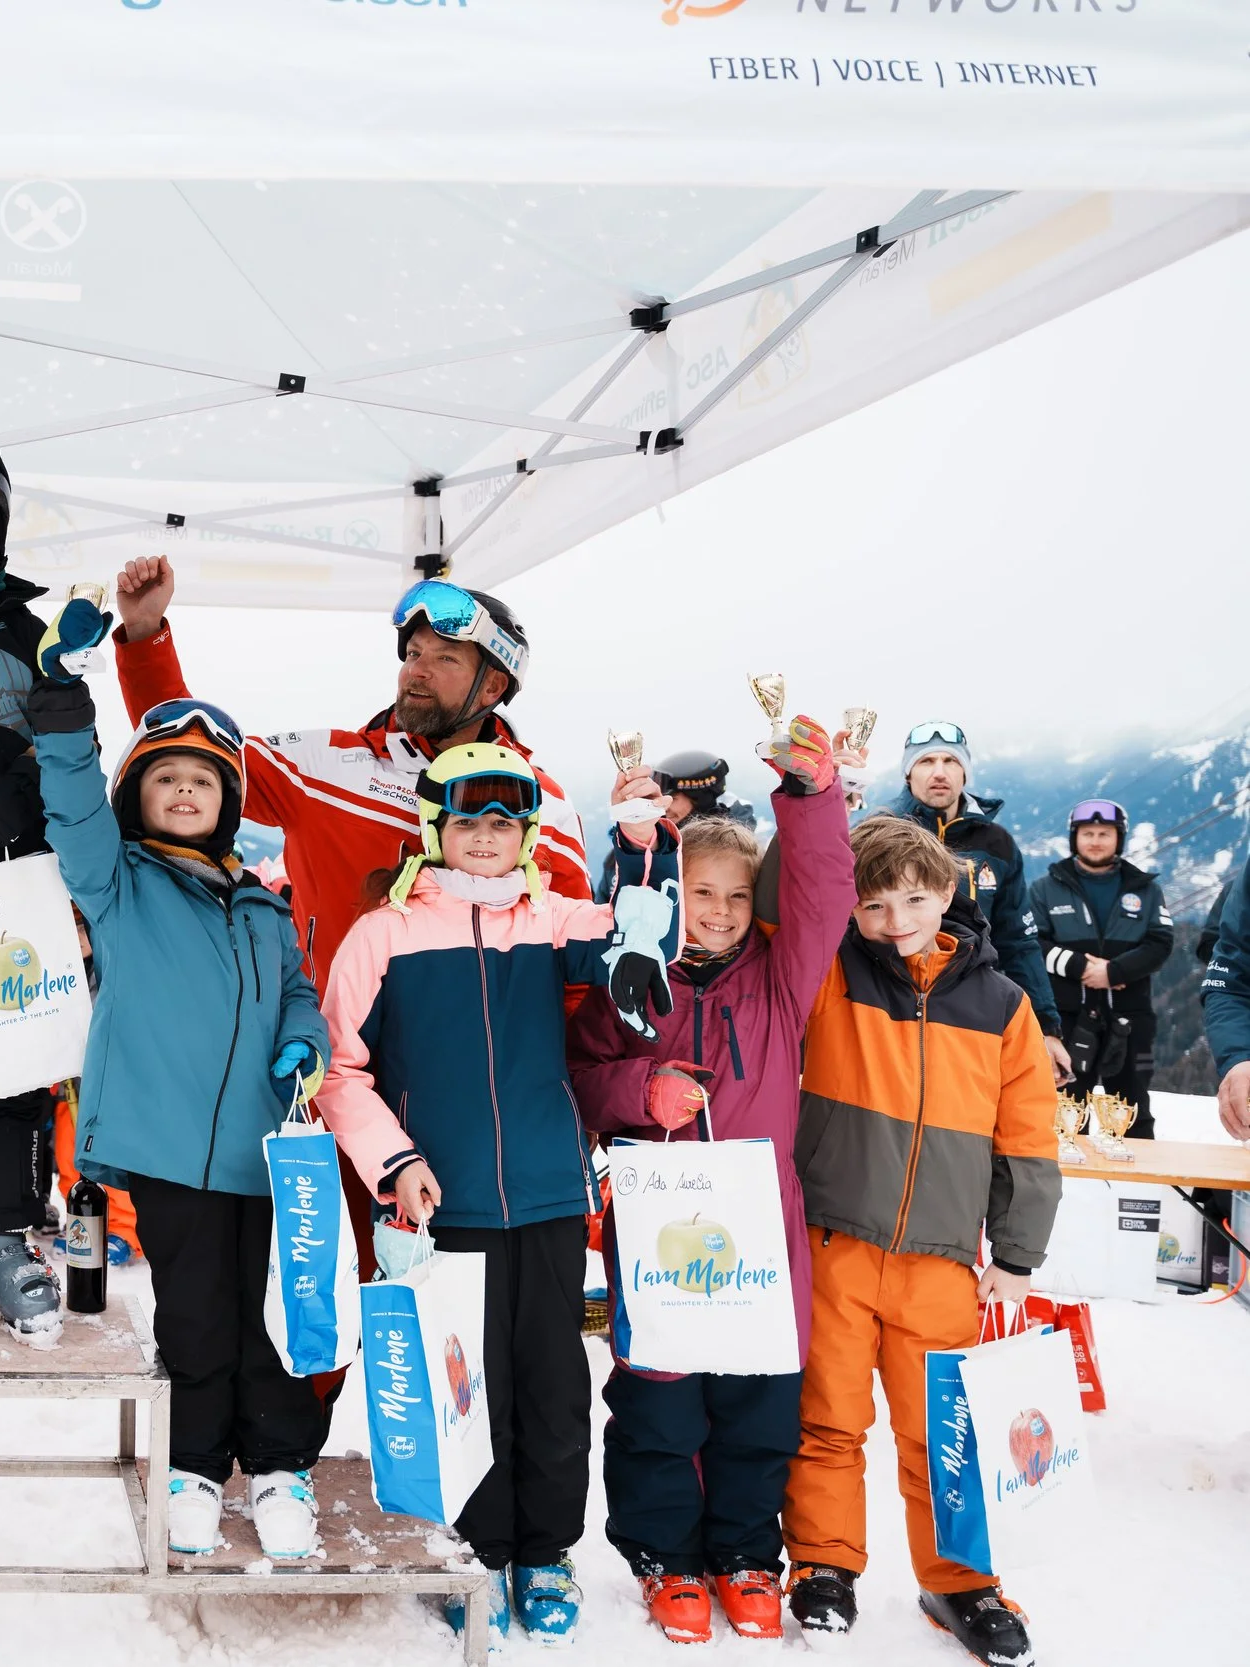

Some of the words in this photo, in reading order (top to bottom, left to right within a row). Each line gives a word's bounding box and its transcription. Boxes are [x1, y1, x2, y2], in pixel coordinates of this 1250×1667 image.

[708, 56, 799, 81] FIBER
[831, 58, 923, 83] VOICE
[957, 61, 1100, 88] INTERNET
[0, 969, 77, 1014] Marlene
[45, 1008, 60, 1017] ALPS
[288, 1175, 325, 1263] Marlene
[633, 1259, 640, 1292] I
[643, 1267, 680, 1287] am
[686, 1258, 778, 1298] Marlene
[376, 1329, 422, 1422] Marlene
[940, 1395, 968, 1477] Marlene
[1006, 1471, 1027, 1494] am
[1028, 1446, 1080, 1488] Marlene
